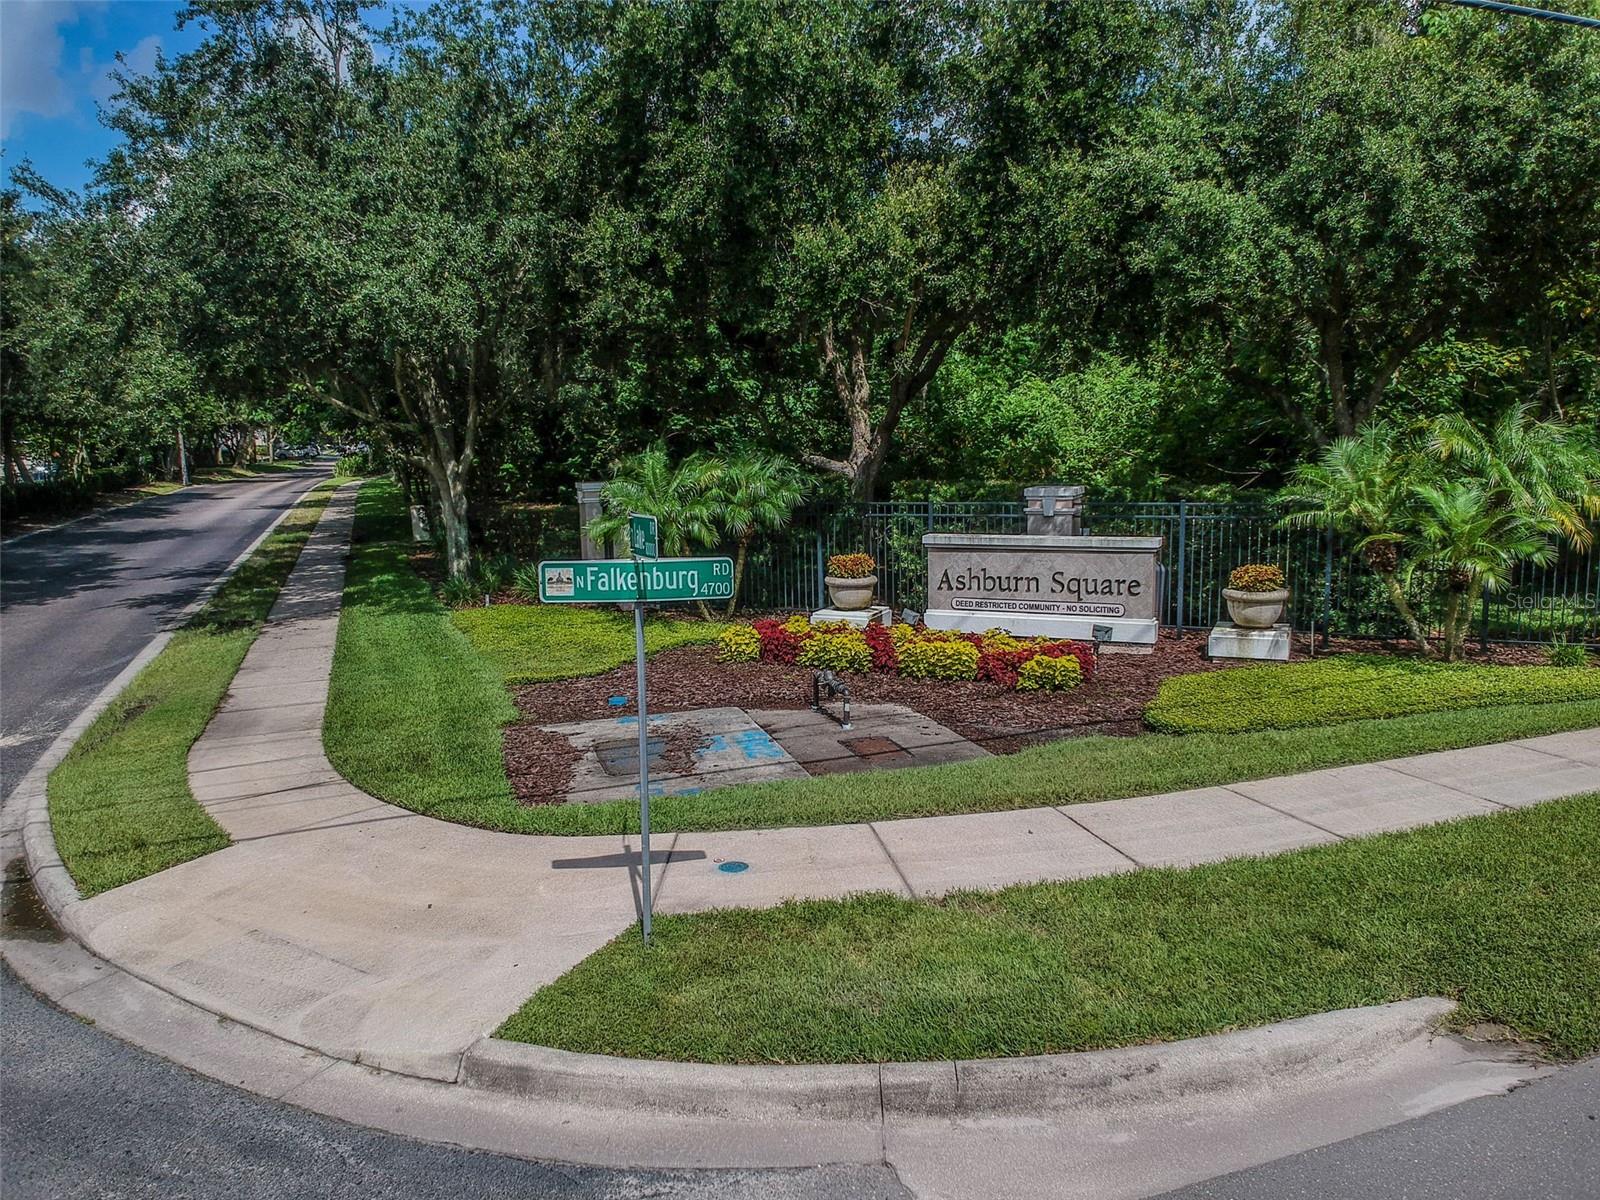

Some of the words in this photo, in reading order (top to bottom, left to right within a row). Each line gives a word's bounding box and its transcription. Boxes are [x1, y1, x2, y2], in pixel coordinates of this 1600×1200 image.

[577, 575, 584, 588] N
[587, 567, 698, 596] Falkenburg
[713, 563, 729, 575] RD
[701, 582, 730, 595] 4700
[937, 568, 1040, 592] Ashburn
[1050, 571, 1141, 601] Square
[975, 601, 1017, 609] RESTRICTED
[1018, 602, 1060, 612] COMMUNITY
[1066, 604, 1077, 612] NO
[1079, 605, 1120, 614] SOLICITING
